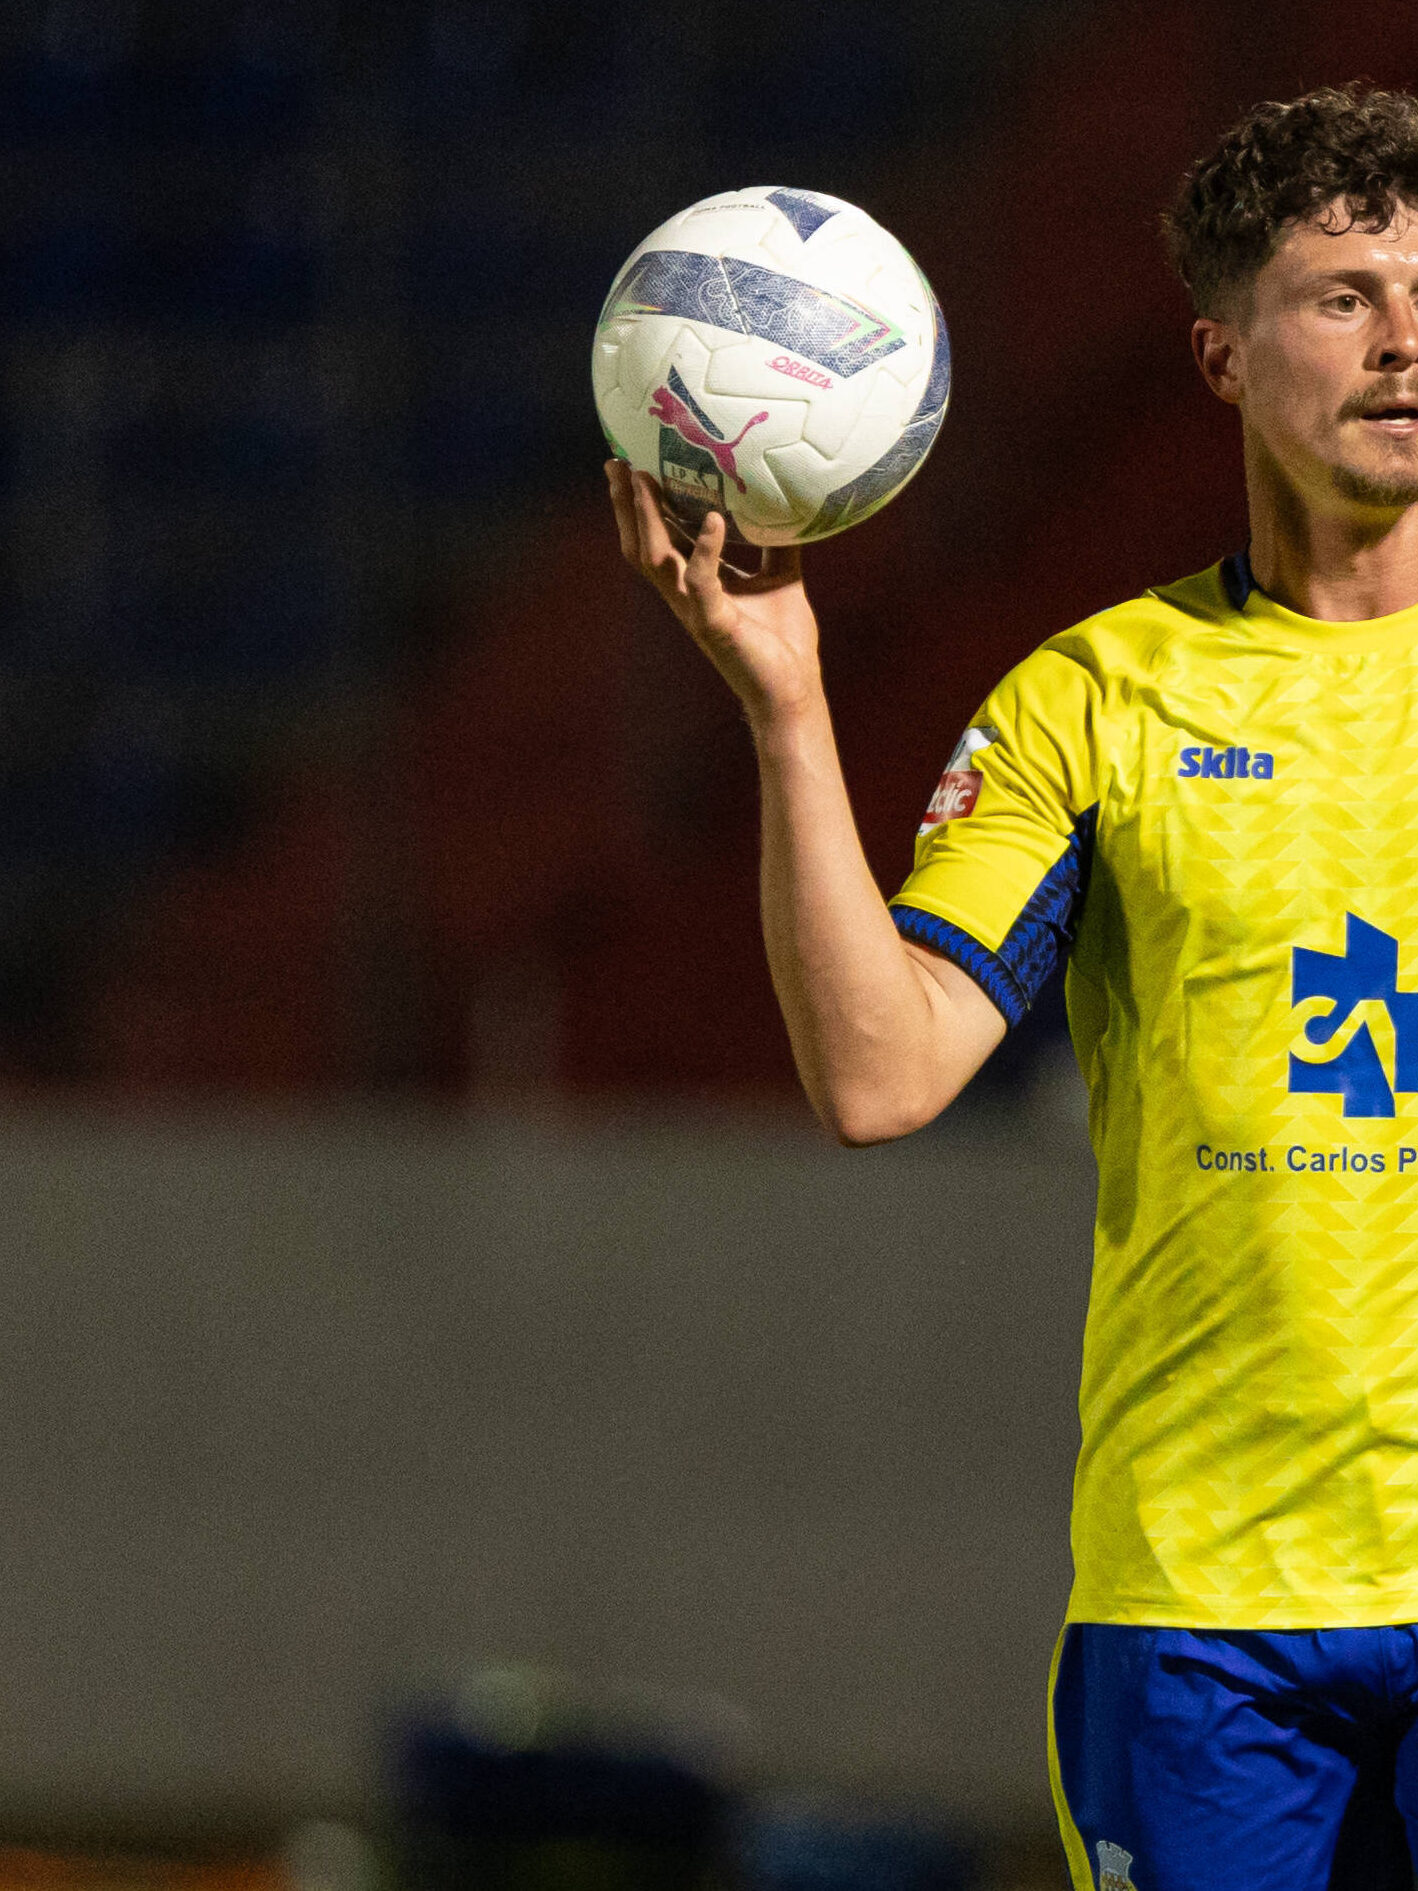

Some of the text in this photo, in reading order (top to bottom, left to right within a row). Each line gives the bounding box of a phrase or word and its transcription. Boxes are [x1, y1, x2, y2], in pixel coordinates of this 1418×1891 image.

[771, 355, 833, 389] ORBITA
[1195, 1145, 1274, 1172] Const.
[1286, 1145, 1386, 1173] Carlos
